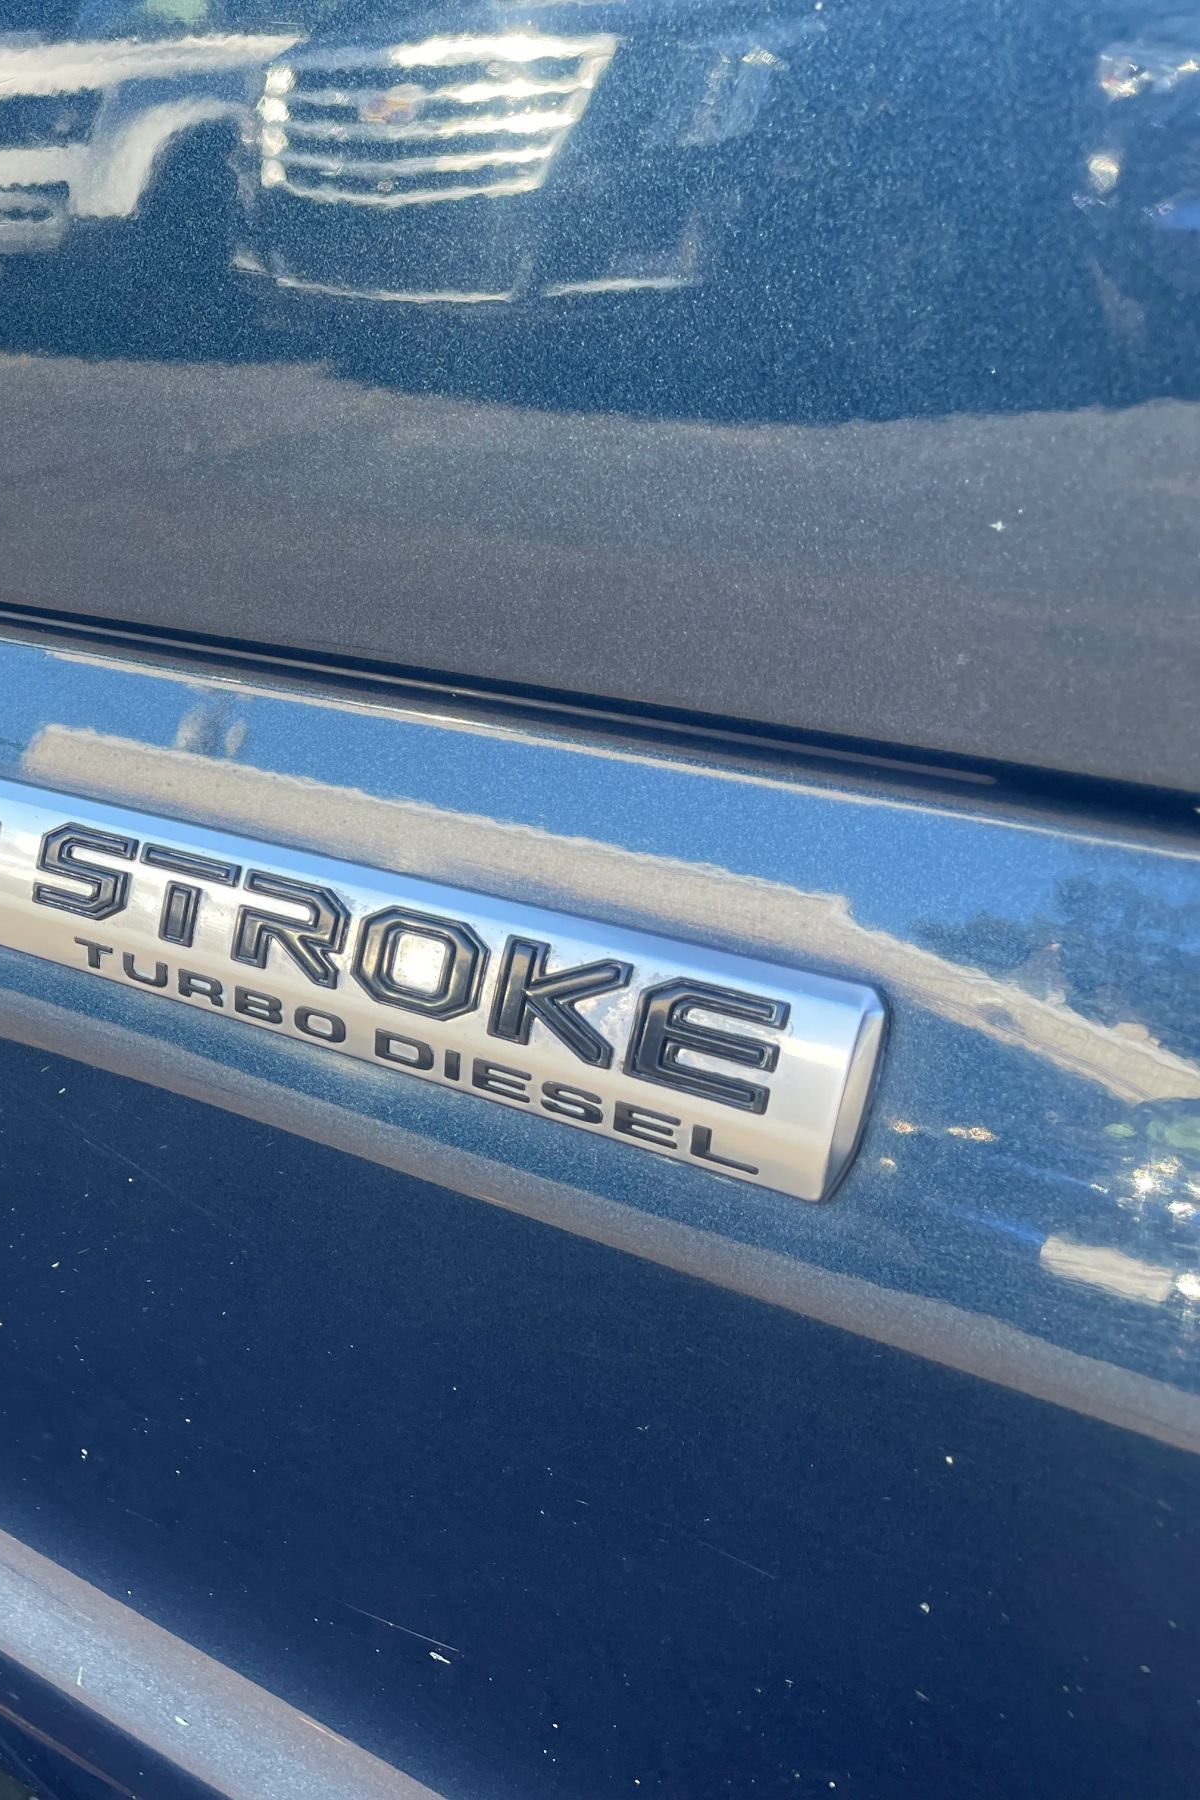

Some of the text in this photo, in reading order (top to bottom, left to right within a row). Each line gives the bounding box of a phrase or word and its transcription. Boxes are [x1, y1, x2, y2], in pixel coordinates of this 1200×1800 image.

[33, 821, 791, 1114] STROKE
[73, 936, 760, 1175] TURBO DIESEL
